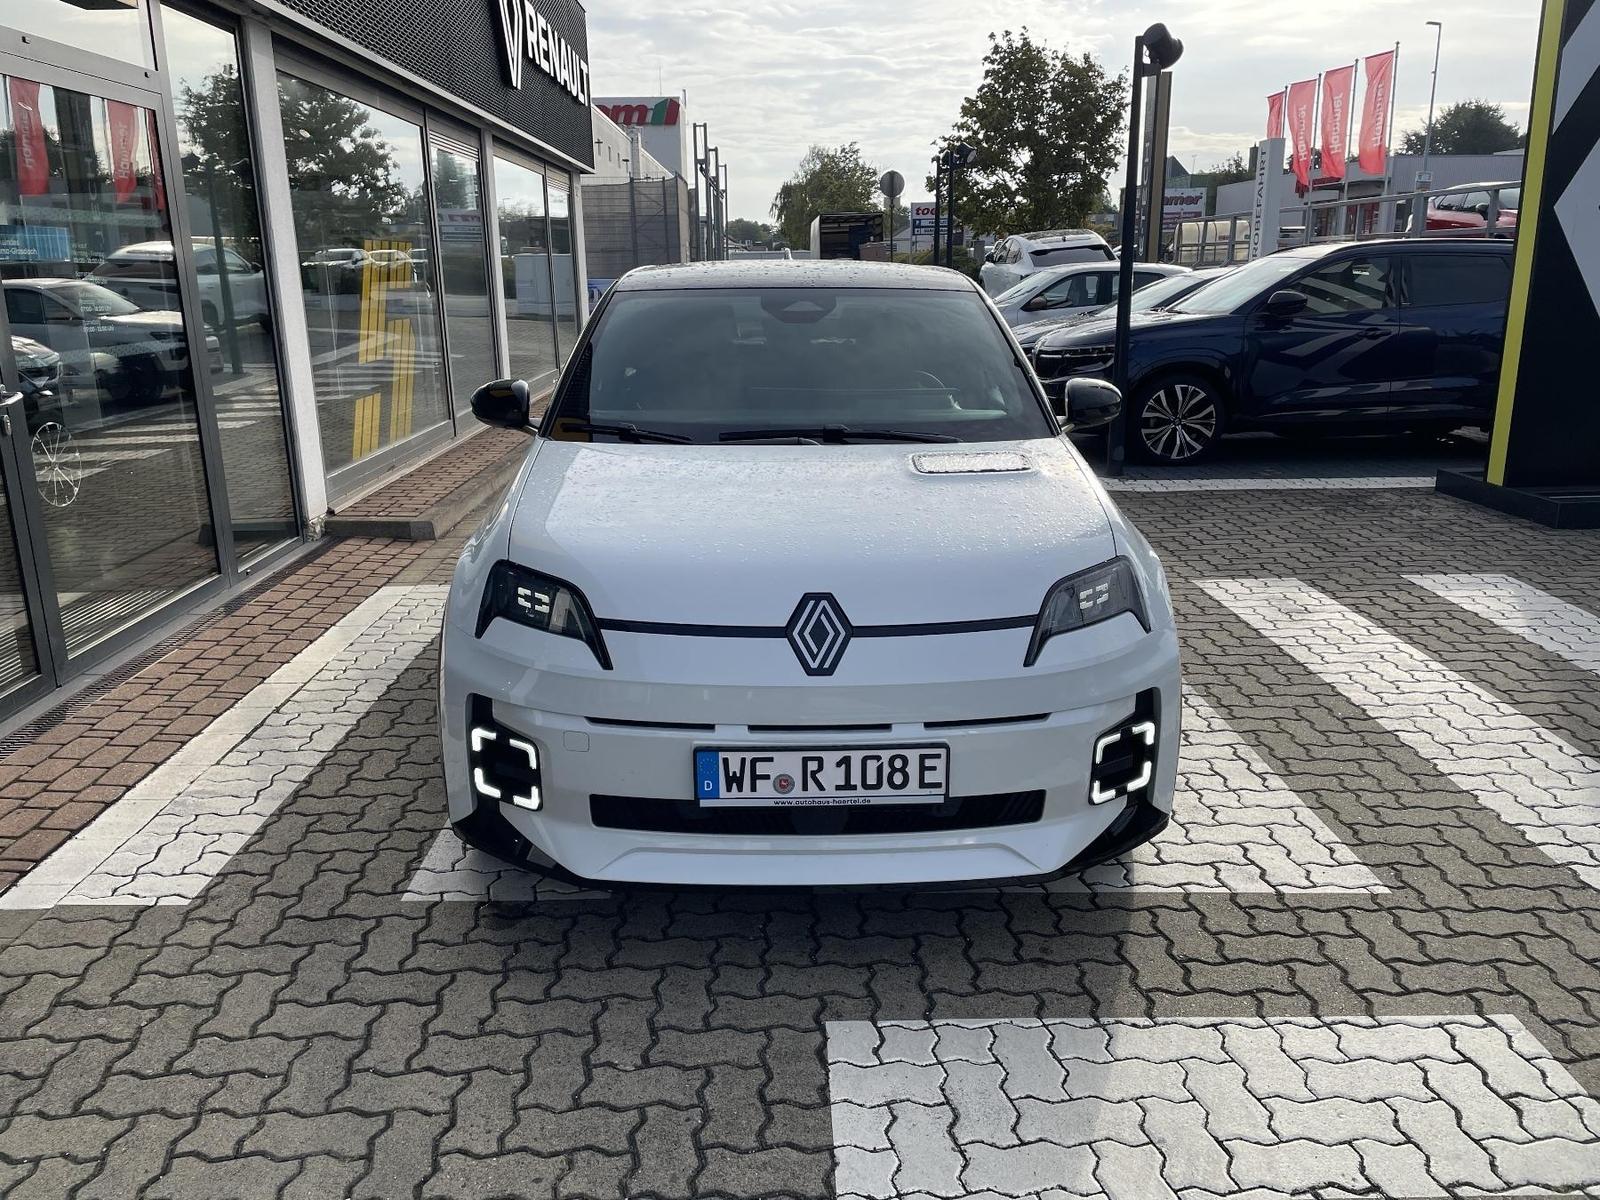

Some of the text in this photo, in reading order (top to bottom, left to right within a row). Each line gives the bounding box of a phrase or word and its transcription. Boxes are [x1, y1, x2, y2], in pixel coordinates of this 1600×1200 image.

[525, 0, 588, 107] RENAULT
[1252, 151, 1267, 258] ROBEFAHRT
[704, 780, 713, 791] D
[722, 756, 774, 793] WF
[773, 797, 872, 807] www.autohaus-haertel.de
